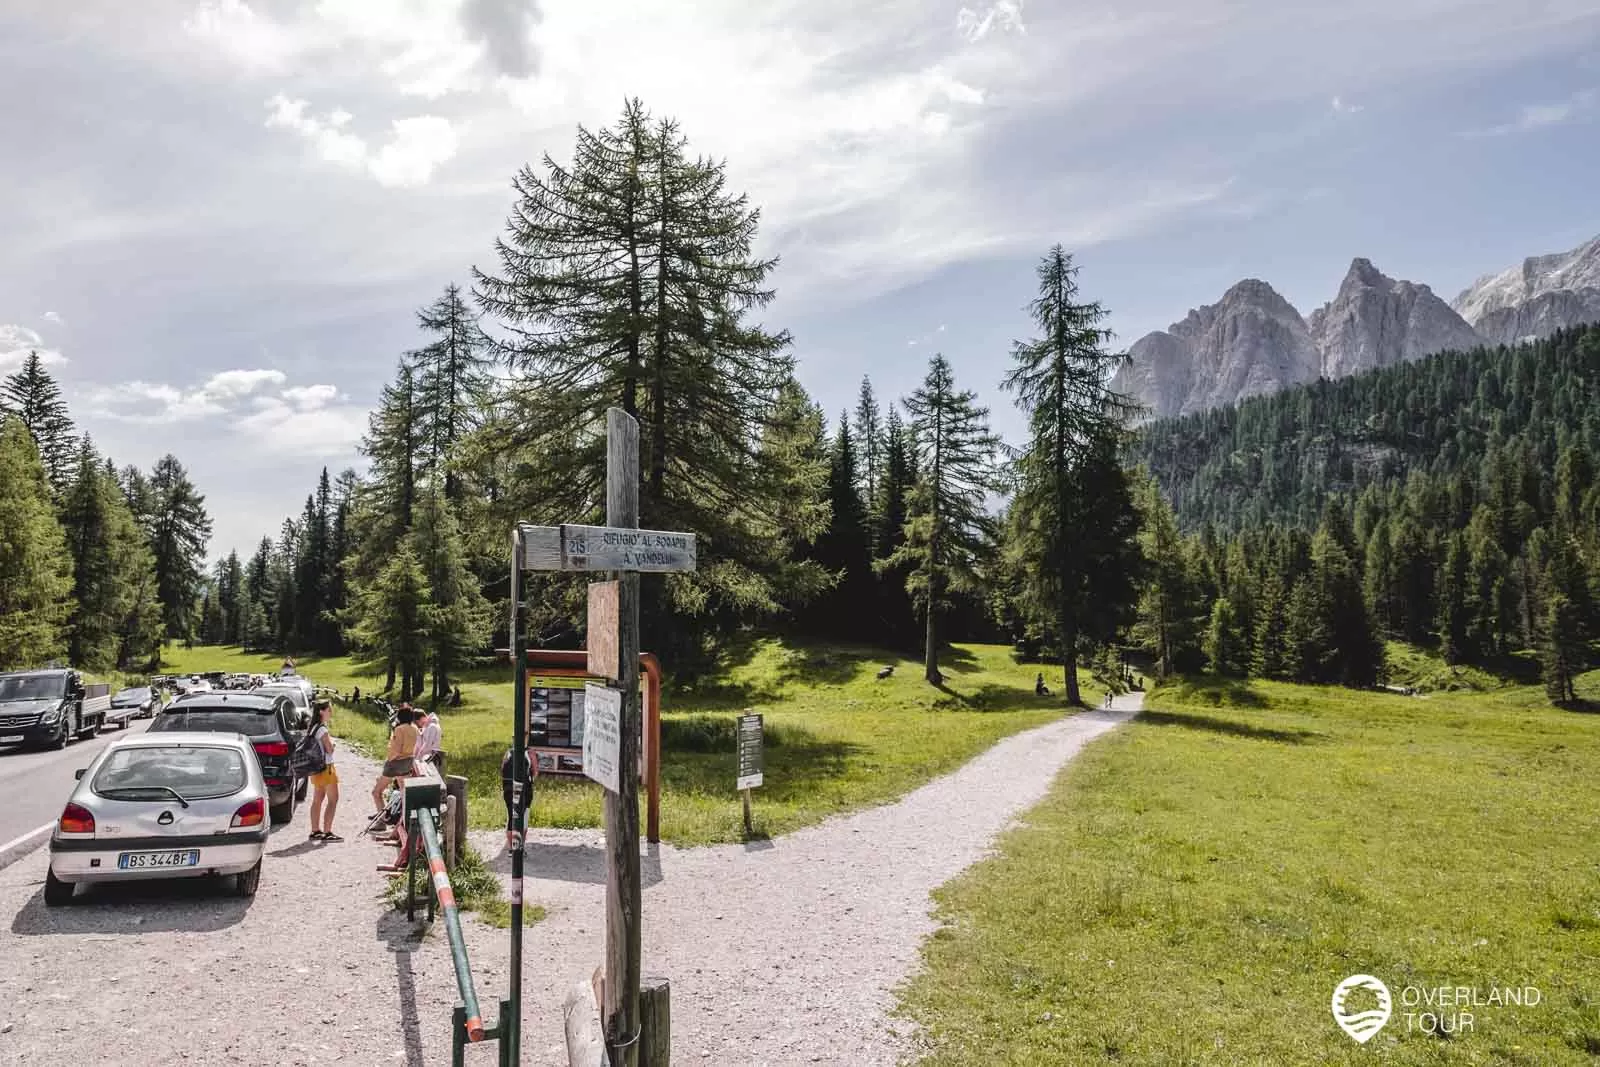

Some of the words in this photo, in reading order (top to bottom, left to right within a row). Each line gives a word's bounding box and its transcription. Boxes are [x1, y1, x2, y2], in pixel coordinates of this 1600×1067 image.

[641, 535, 652, 547] AL
[130, 855, 146, 867] BS
[150, 853, 188, 866] 344BF
